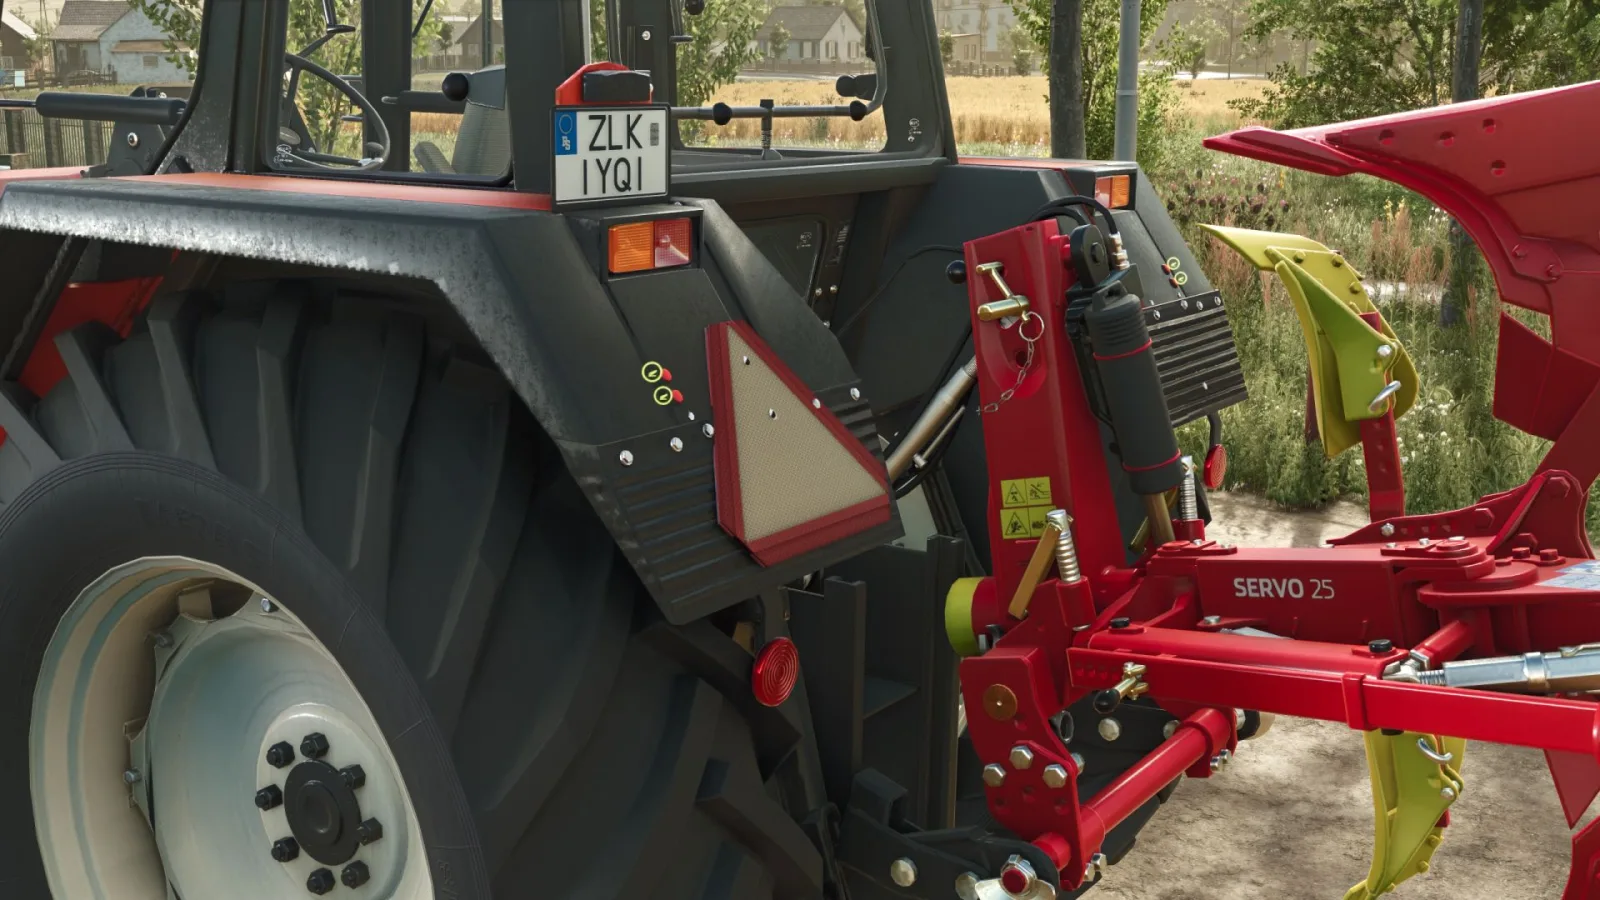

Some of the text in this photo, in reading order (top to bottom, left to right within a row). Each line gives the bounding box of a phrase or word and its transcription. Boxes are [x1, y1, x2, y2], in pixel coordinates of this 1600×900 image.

[588, 114, 643, 151] ZLK
[1233, 577, 1335, 599] SERVO 25
